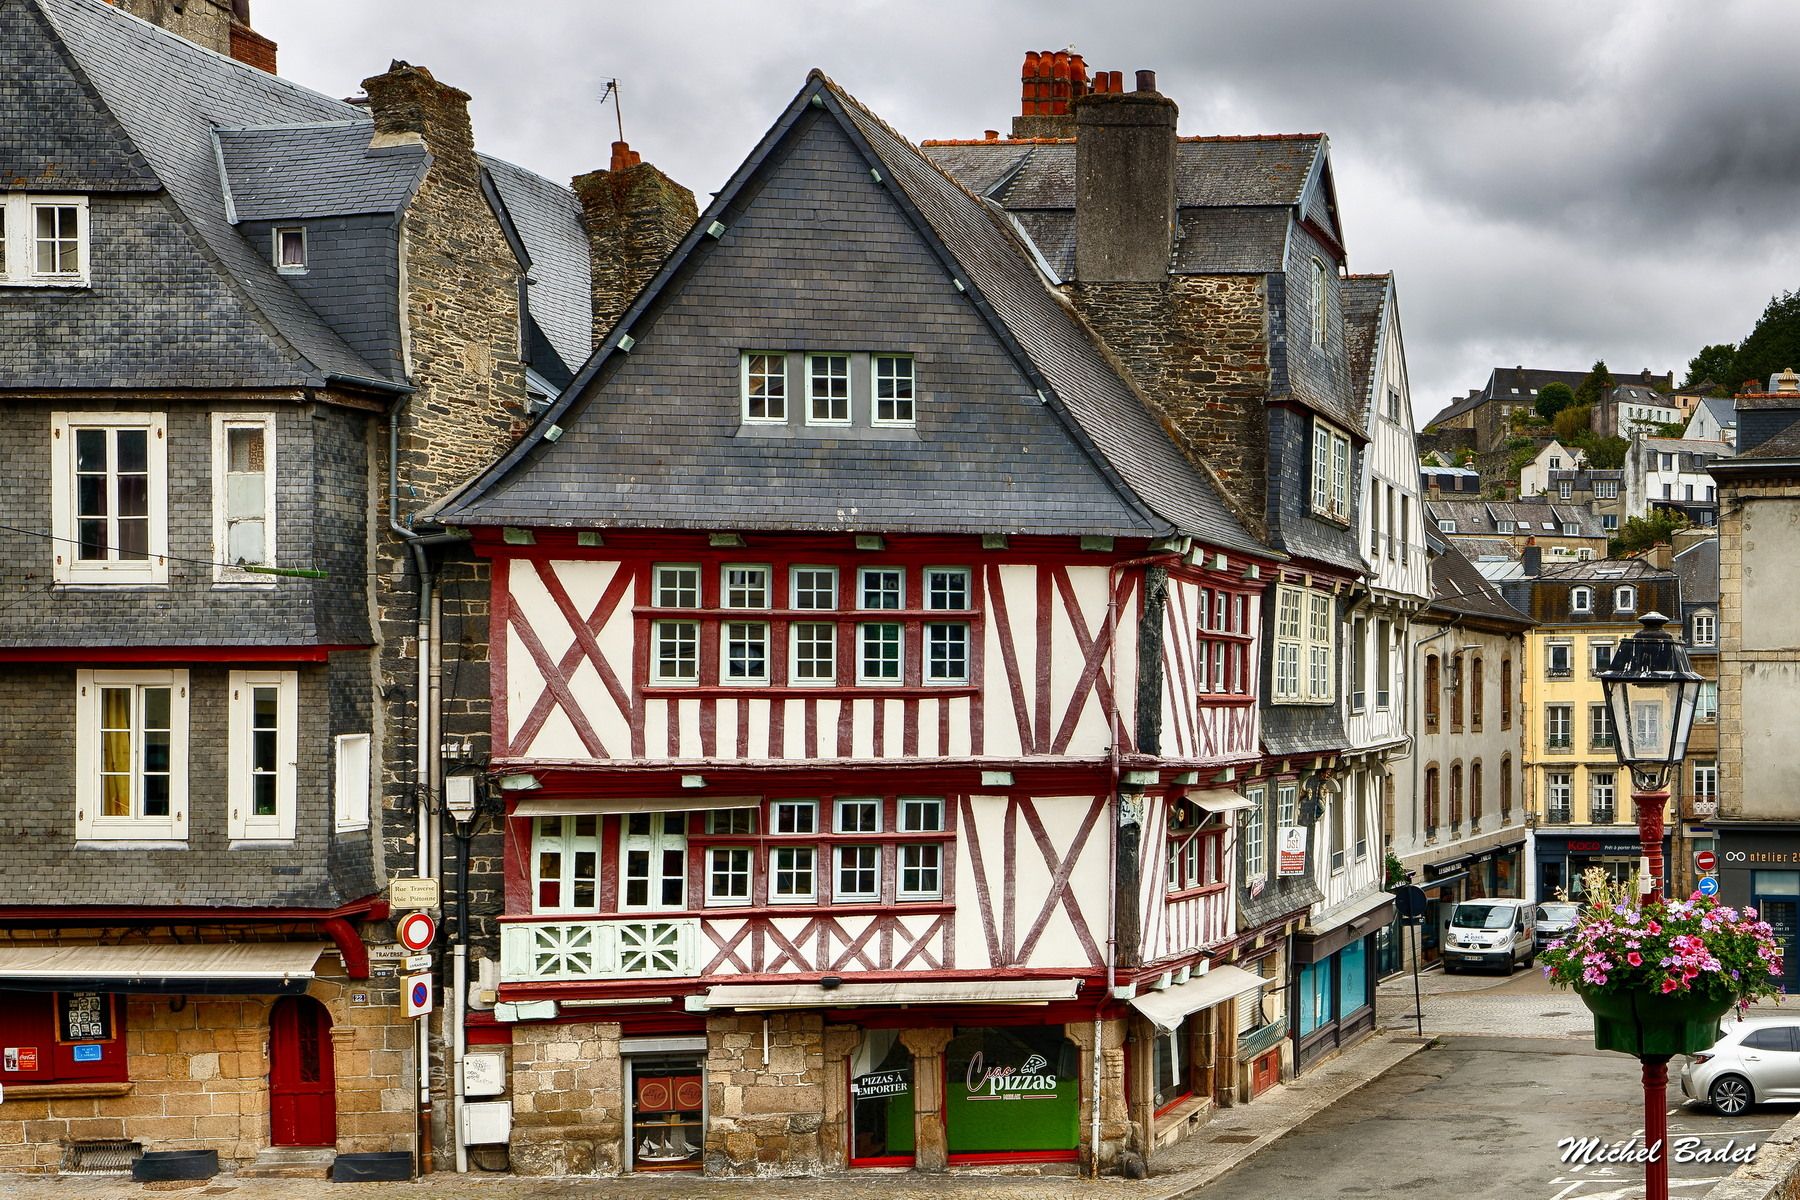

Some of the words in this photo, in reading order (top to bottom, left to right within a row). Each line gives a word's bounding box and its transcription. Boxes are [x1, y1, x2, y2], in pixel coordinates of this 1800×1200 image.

[1750, 852, 1788, 862] atelier
[862, 1075, 894, 1085] PIZZAS
[896, 1071, 903, 1082] À
[966, 1050, 1016, 1092] Ciao
[857, 1082, 908, 1096] EMPORTER
[989, 1073, 1057, 1095] pizzas
